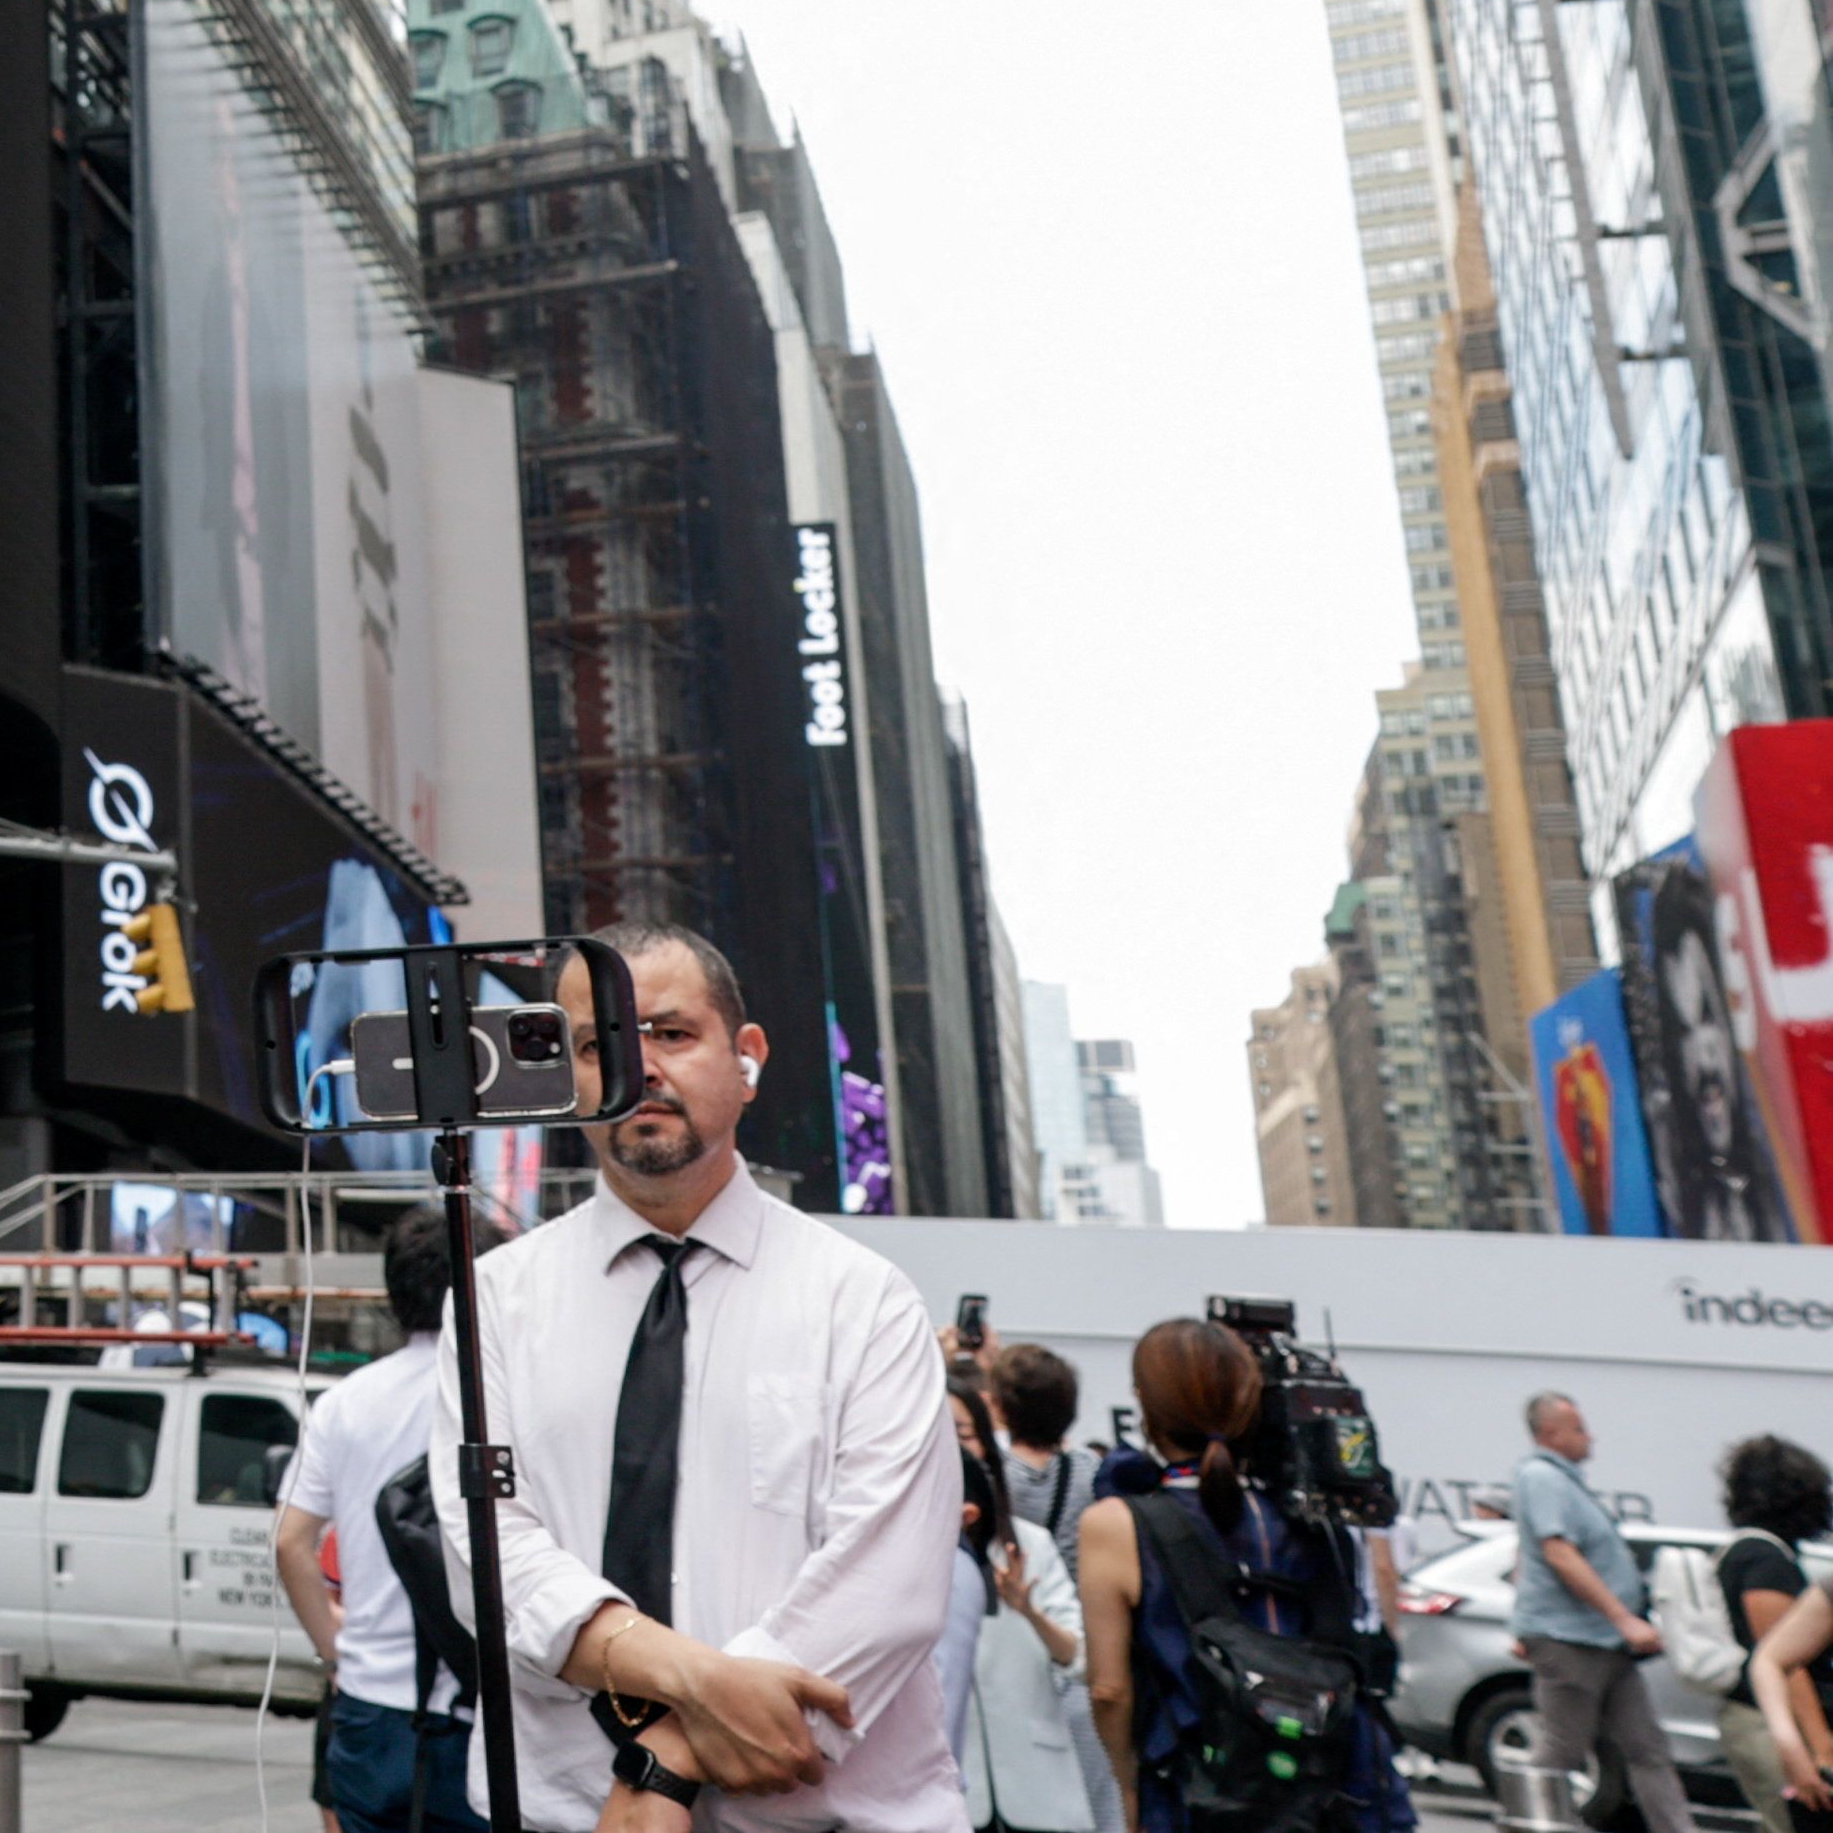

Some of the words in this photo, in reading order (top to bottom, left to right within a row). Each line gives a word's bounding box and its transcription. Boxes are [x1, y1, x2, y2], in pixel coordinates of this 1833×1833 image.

[793, 527, 840, 655] Locker
[801, 660, 848, 747] Foot
[99, 860, 149, 1014] Grok
